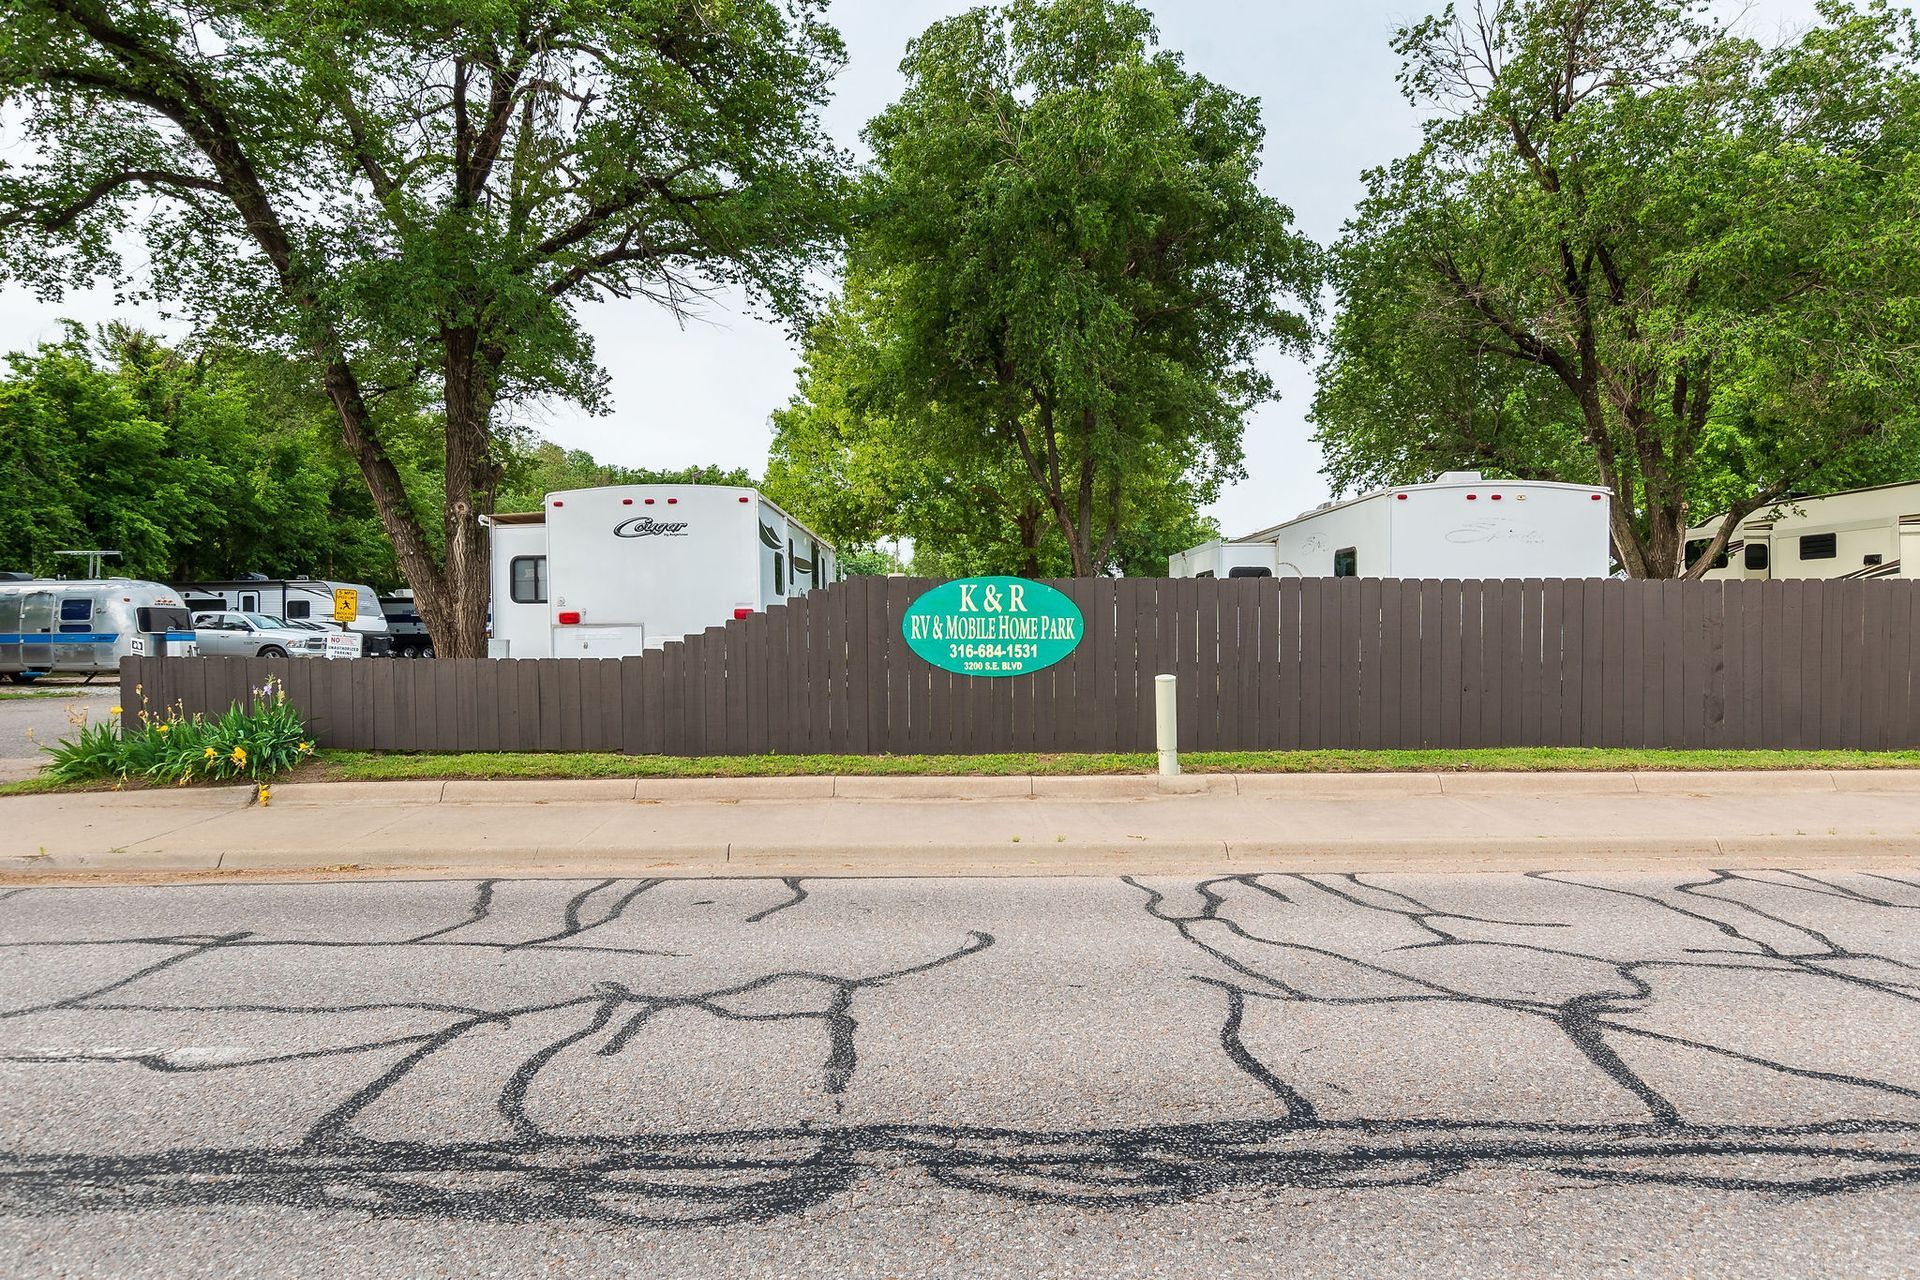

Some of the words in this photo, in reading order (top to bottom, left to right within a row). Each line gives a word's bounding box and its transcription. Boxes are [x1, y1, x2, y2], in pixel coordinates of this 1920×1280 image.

[613, 516, 688, 538] Cougar
[959, 584, 979, 612] K
[983, 584, 1003, 613] &
[1009, 584, 1028, 612] R
[911, 615, 930, 640] RV
[932, 614, 943, 640] &
[945, 615, 996, 640] MOBILE
[998, 615, 1038, 640] HOME
[1040, 615, 1076, 640] PARK
[949, 644, 1038, 659] 316-684-1531
[964, 661, 983, 671] 3200
[985, 661, 1000, 671] S.E.
[1002, 661, 1023, 671] BLVD
